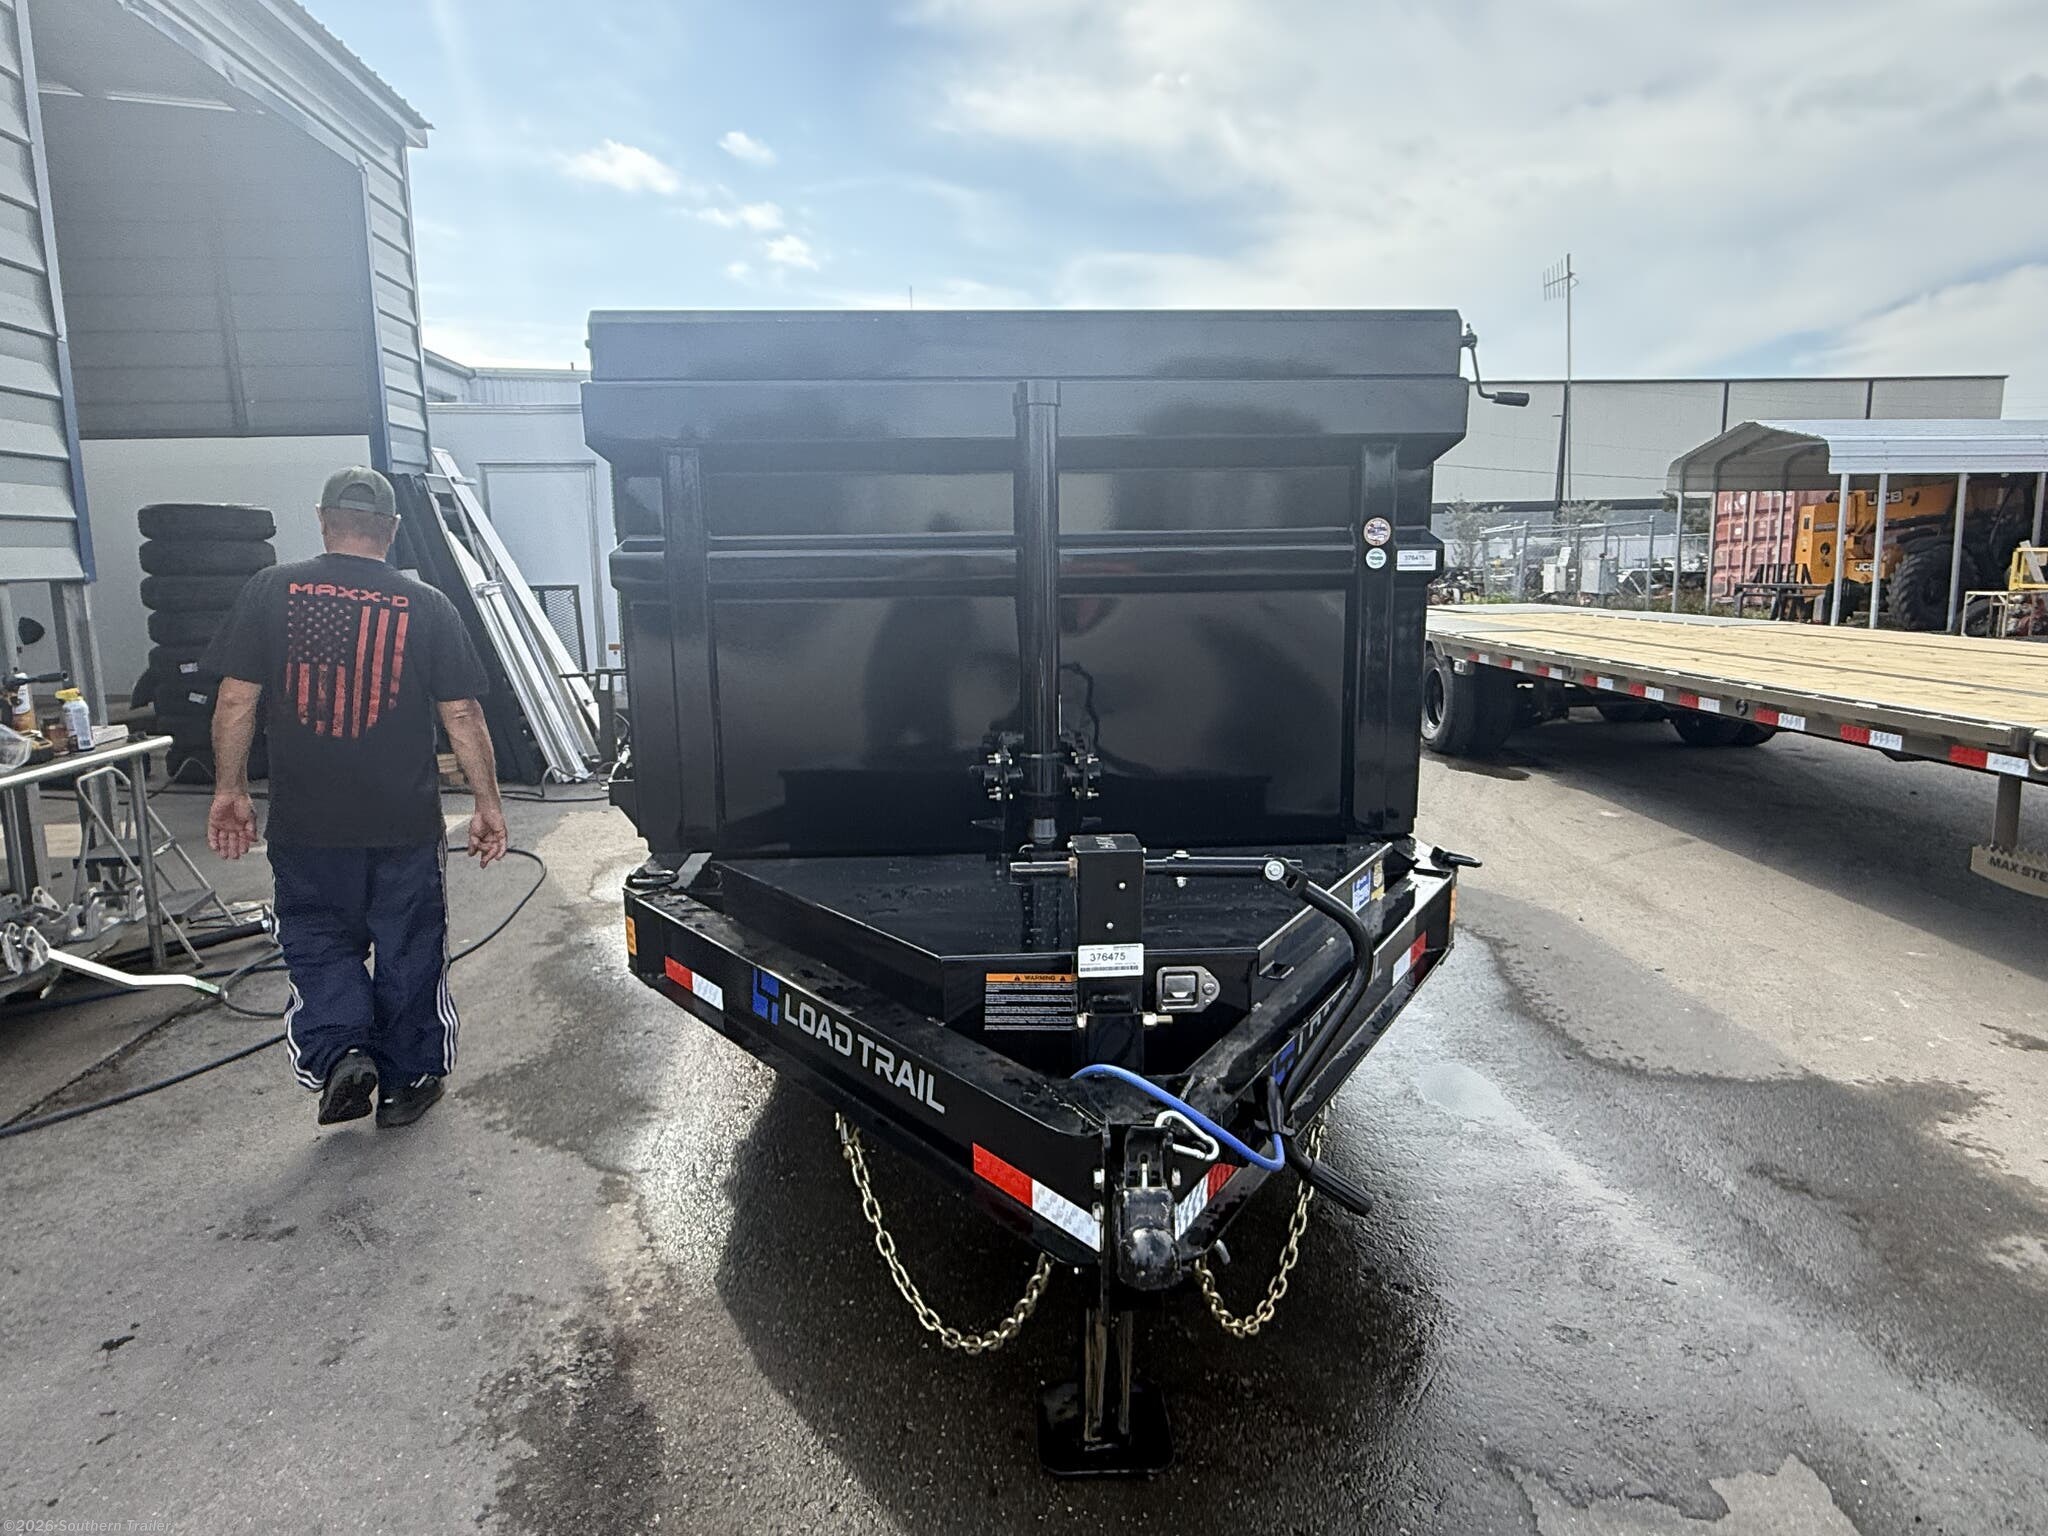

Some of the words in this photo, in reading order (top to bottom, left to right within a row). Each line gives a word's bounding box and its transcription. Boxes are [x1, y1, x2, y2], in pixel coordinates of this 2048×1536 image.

[1867, 490, 1903, 506] JB
[1855, 562, 1875, 572] JC
[289, 582, 409, 608] MAXX-D
[1989, 856, 2019, 873] MAX
[1090, 952, 1127, 962] 376475
[784, 993, 853, 1057] LOAD
[857, 1034, 946, 1114] TRAIL
